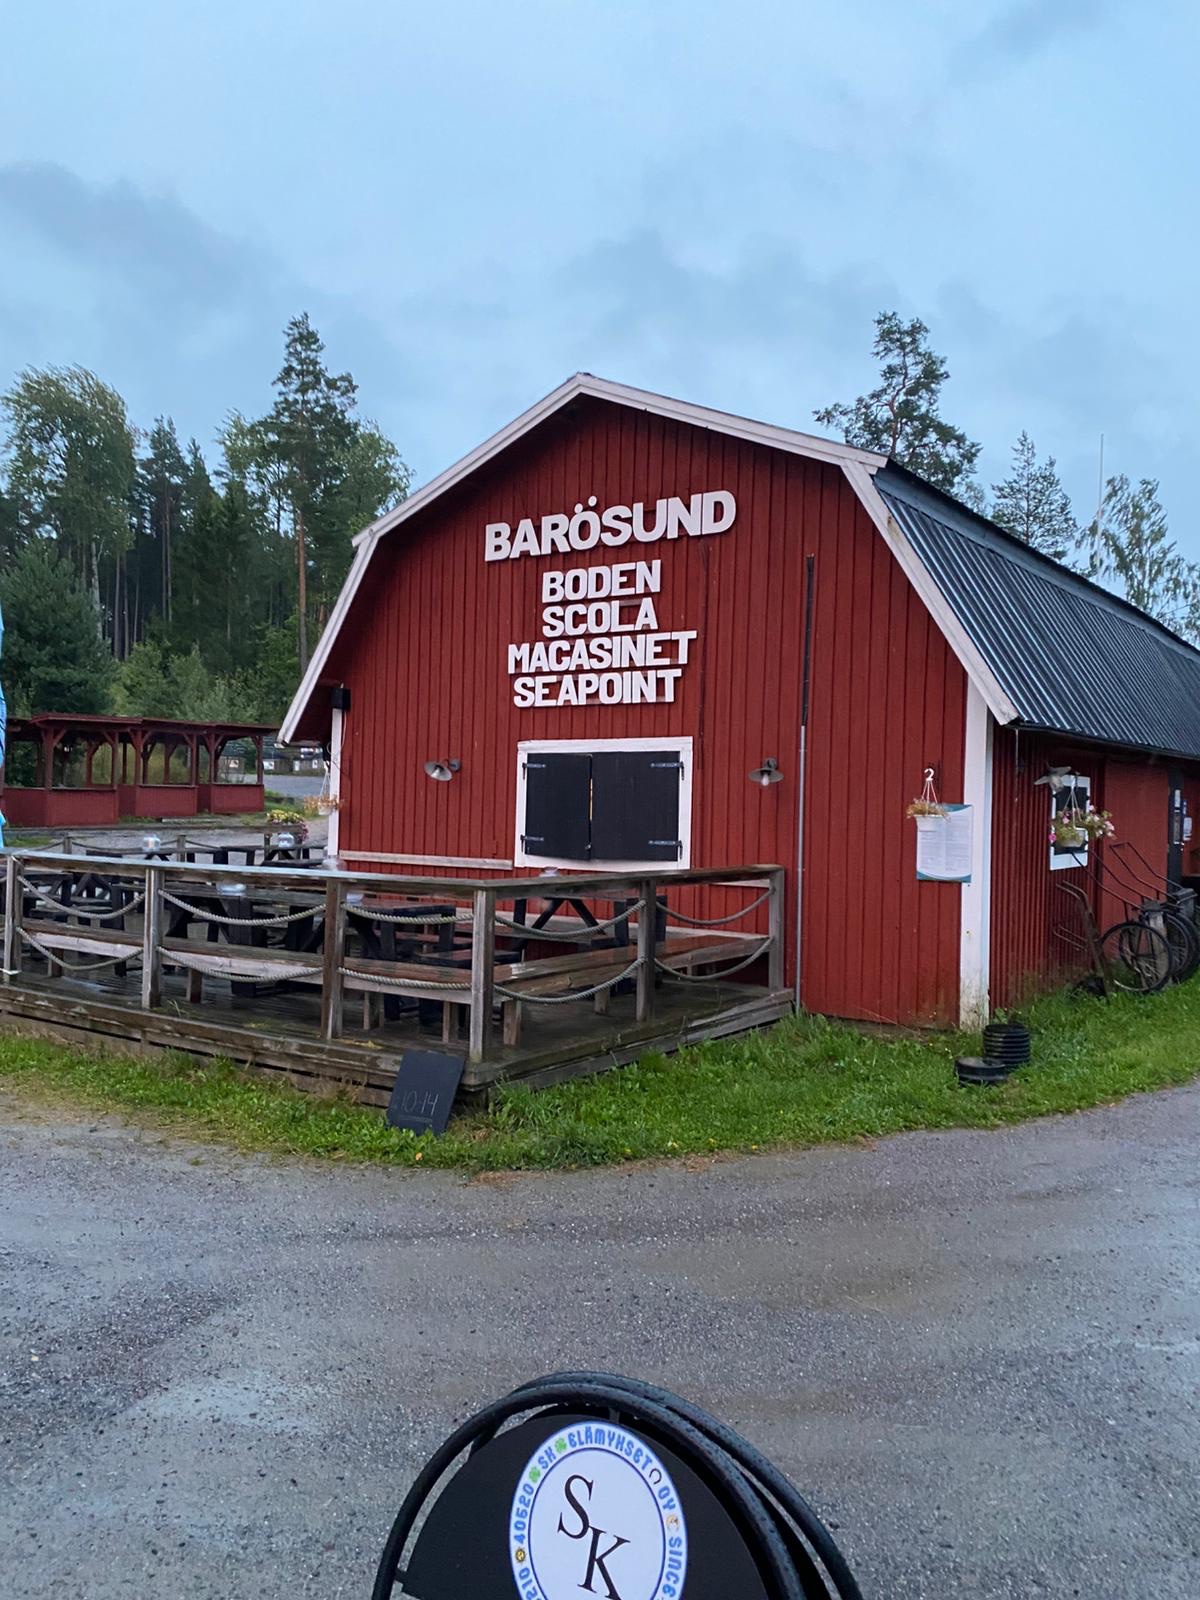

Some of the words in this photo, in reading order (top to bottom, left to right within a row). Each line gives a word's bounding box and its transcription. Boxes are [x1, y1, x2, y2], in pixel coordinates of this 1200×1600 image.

[485, 490, 736, 561] BARÖSUND
[542, 560, 661, 603] BODEN
[542, 597, 658, 637] SCOLA
[508, 630, 697, 674] MAGASINET
[513, 669, 682, 707] SEAPOINT
[538, 1447, 556, 1470] SK
[658, 1486, 676, 1511] OY
[662, 1536, 682, 1597] SINCE
